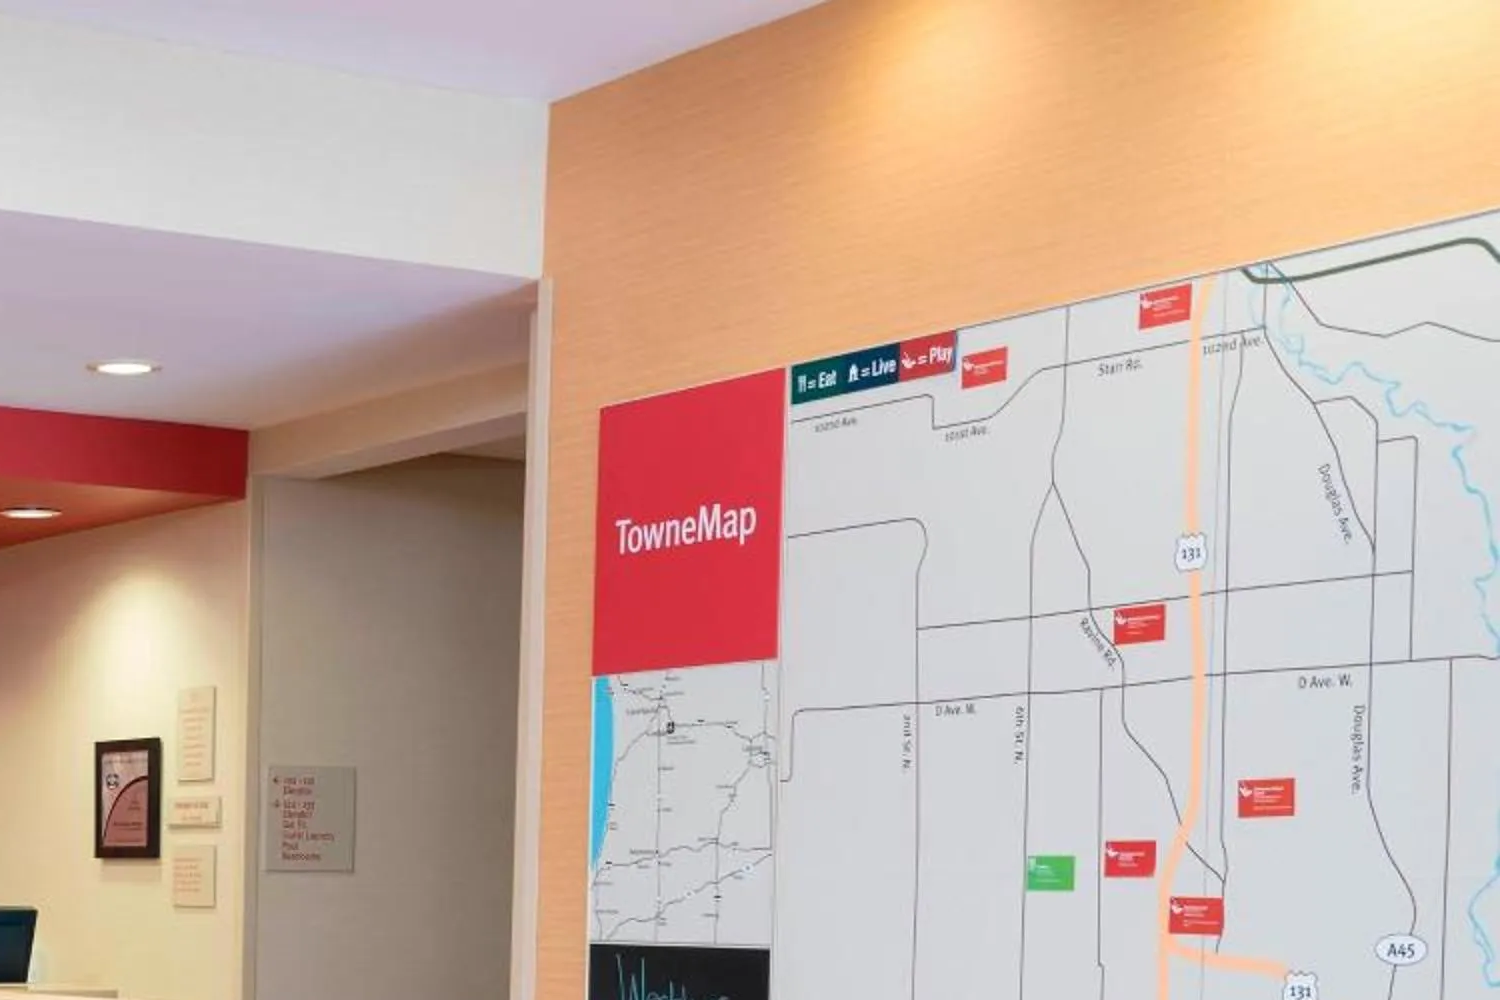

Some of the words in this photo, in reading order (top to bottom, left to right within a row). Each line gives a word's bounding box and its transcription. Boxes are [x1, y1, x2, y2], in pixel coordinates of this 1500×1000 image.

[929, 346, 953, 364] Play
[871, 357, 896, 376] Live
[818, 370, 837, 389] Eat
[1318, 463, 1343, 517] Douglas
[615, 503, 757, 555] TowneMap
[1182, 547, 1201, 562] 131
[1298, 676, 1307, 689] D
[1309, 676, 1336, 688] Ave.
[1340, 673, 1353, 688] W.
[1350, 705, 1366, 761] Douglas
[1351, 765, 1364, 795] Ave.
[1387, 943, 1415, 958] A45
[1290, 986, 1311, 1000] 131
